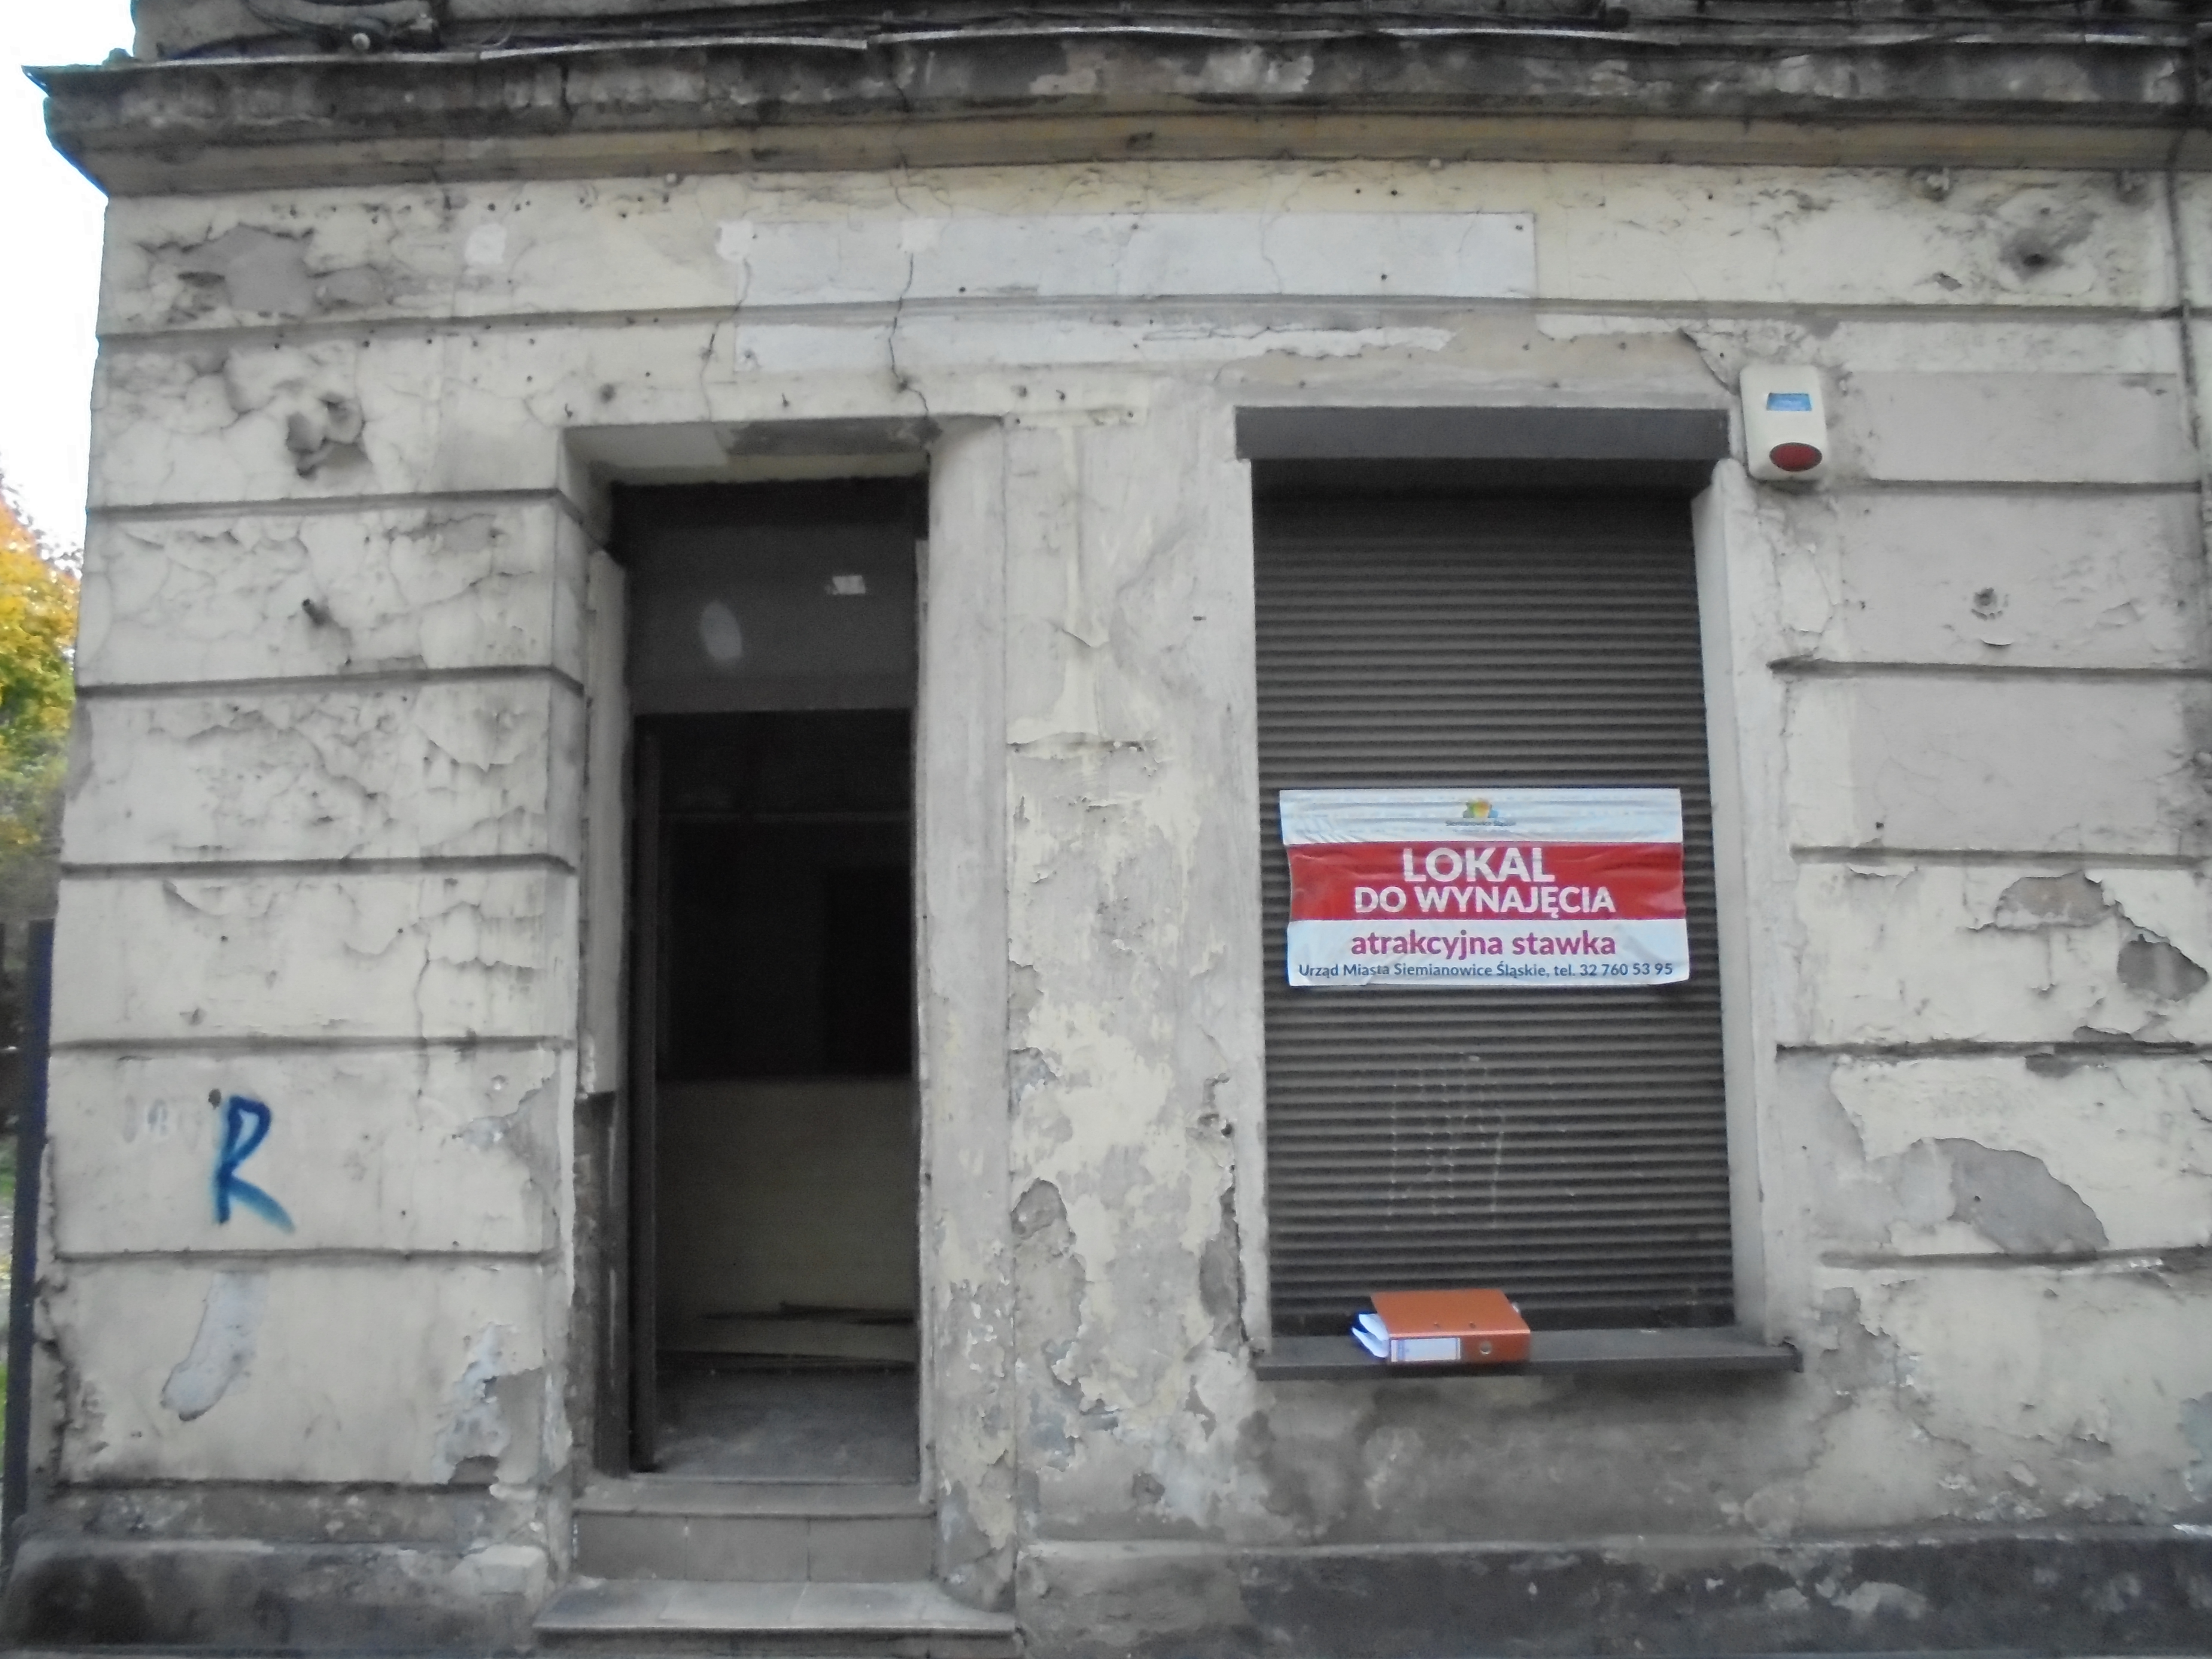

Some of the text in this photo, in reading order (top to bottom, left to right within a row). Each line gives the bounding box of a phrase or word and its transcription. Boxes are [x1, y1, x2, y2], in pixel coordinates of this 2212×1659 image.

[1403, 847, 1556, 882] LOKAL
[1355, 886, 1616, 918] DO WYNAJĘCIA
[1351, 929, 1616, 960] atrakcyjna stawka
[1299, 960, 1673, 978] Urząd Miasta Siemianowice Śląskie, tel. 32 760 53 95
